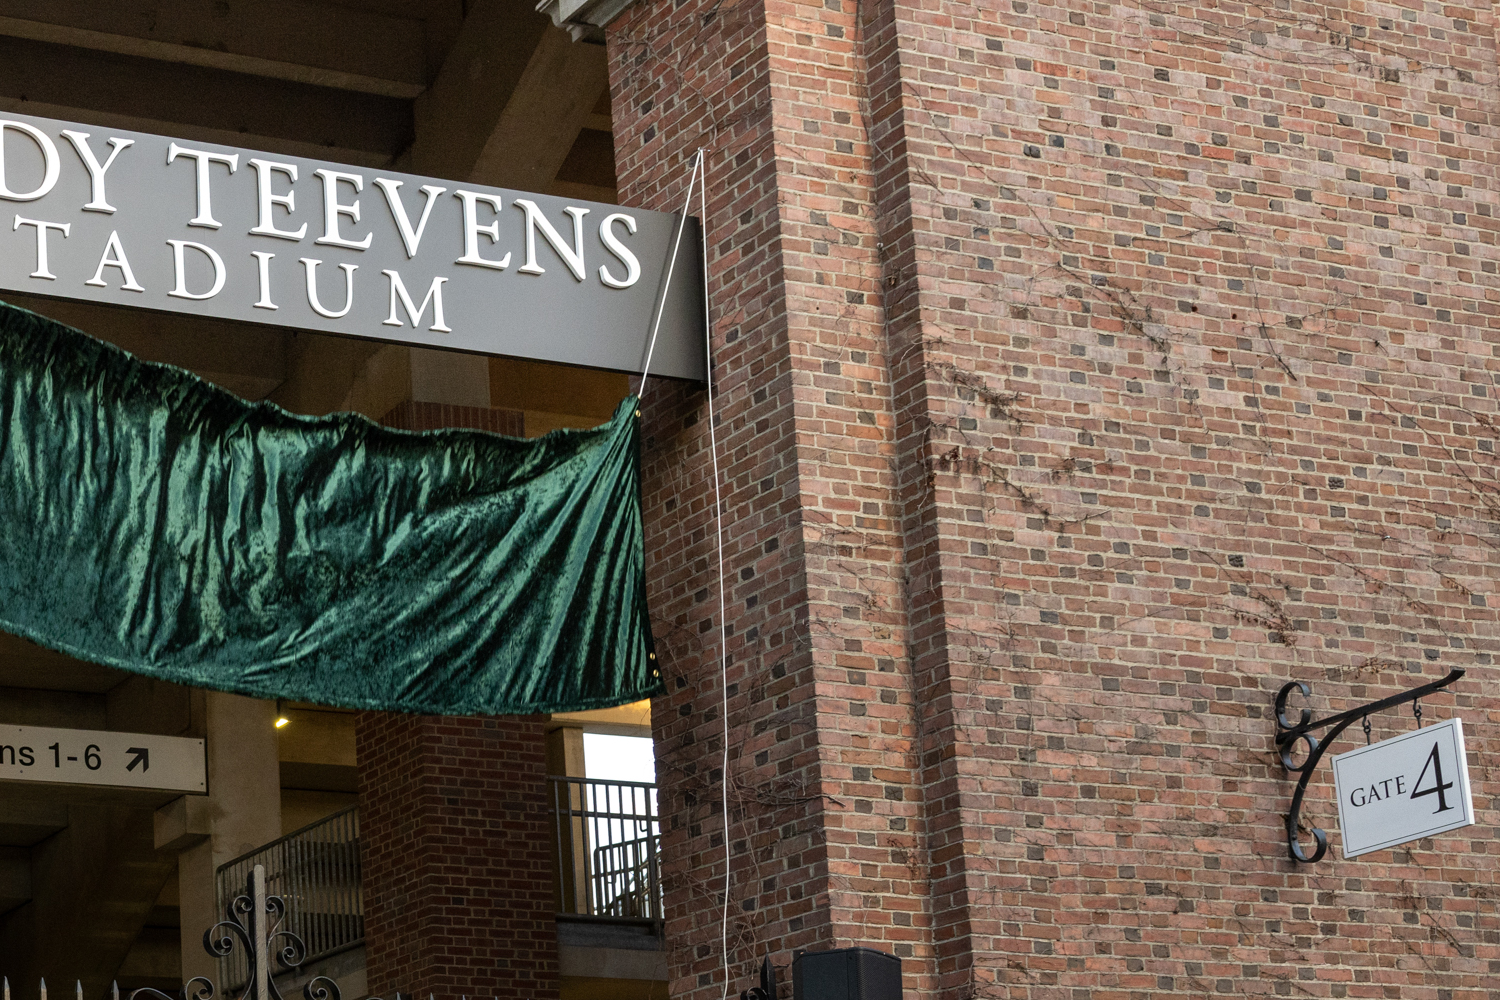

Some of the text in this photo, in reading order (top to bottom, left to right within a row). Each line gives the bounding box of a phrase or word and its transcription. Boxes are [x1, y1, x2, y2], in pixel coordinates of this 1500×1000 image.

[167, 142, 642, 289] TEEVENS
[1350, 741, 1455, 815] GATE 4
